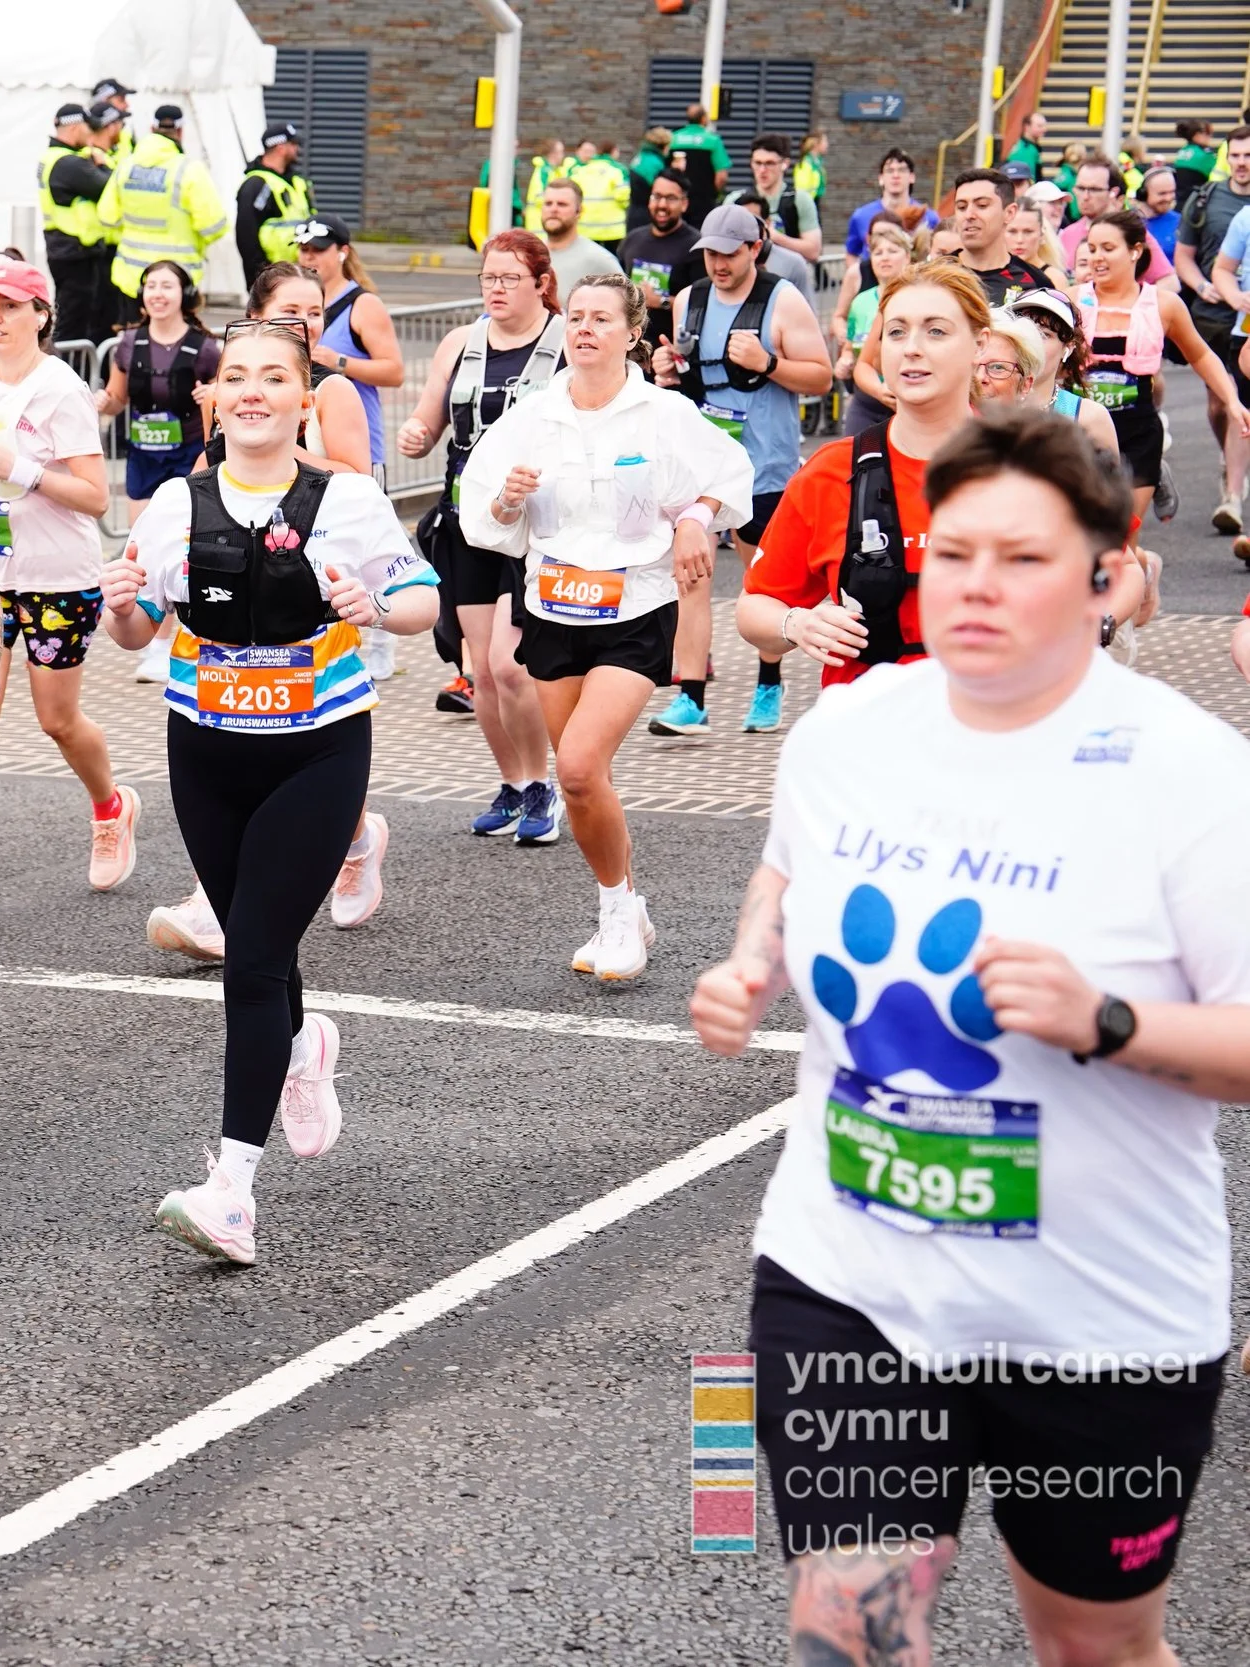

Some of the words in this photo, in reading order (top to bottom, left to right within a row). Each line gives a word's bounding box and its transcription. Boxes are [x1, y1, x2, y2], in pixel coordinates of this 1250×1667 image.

[540, 568, 566, 578] EMILY
[552, 579, 604, 604] 4409
[250, 649, 290, 657] SWANSEA
[199, 670, 240, 684] MOLLY
[219, 686, 291, 711] 4203
[220, 717, 292, 728] #RUNSWANSEA
[833, 824, 928, 873] Llys
[950, 848, 1065, 892] Nini
[858, 1146, 996, 1216] 7595
[226, 1212, 242, 1225] HOKA
